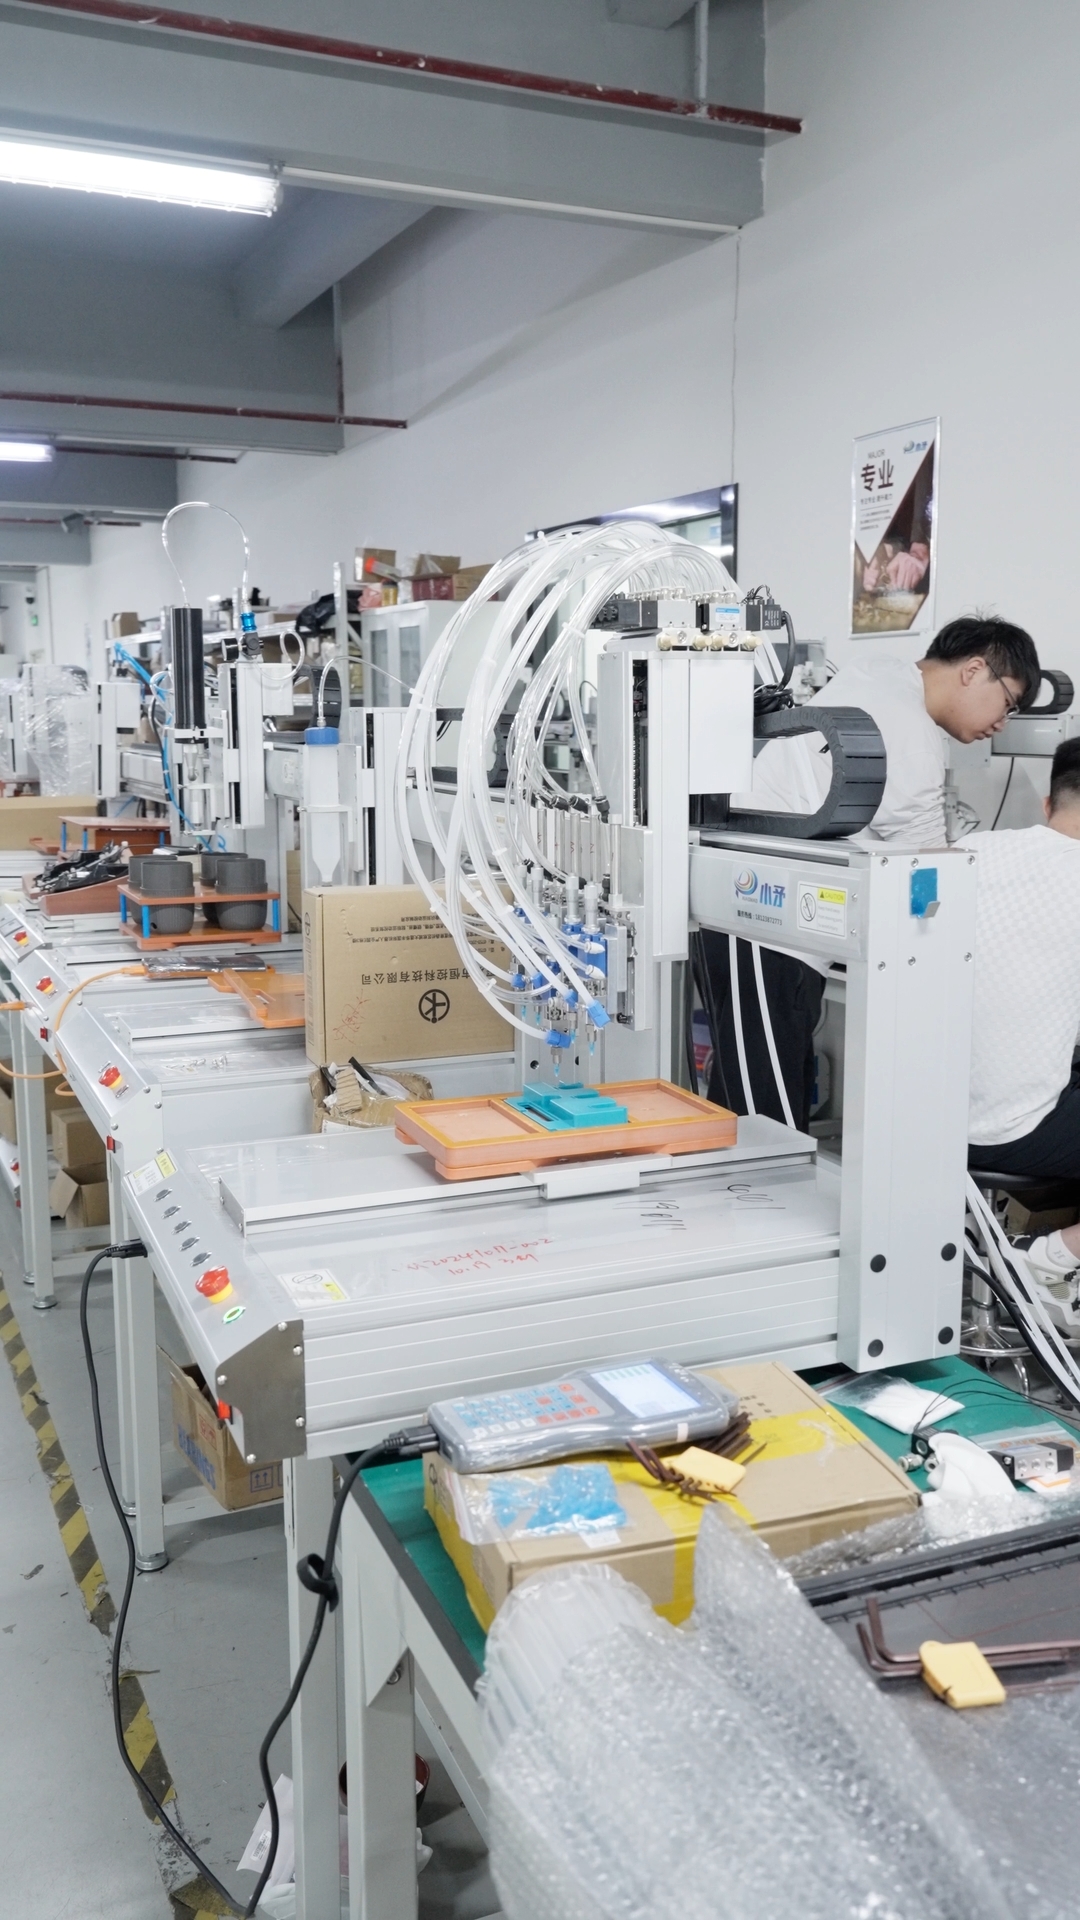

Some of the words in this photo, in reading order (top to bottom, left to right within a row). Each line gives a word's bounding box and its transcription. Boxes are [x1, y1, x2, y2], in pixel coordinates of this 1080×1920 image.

[860, 458, 895, 492] 专业
[759, 882, 786, 908] 小矛
[825, 892, 844, 901] CAUTION
